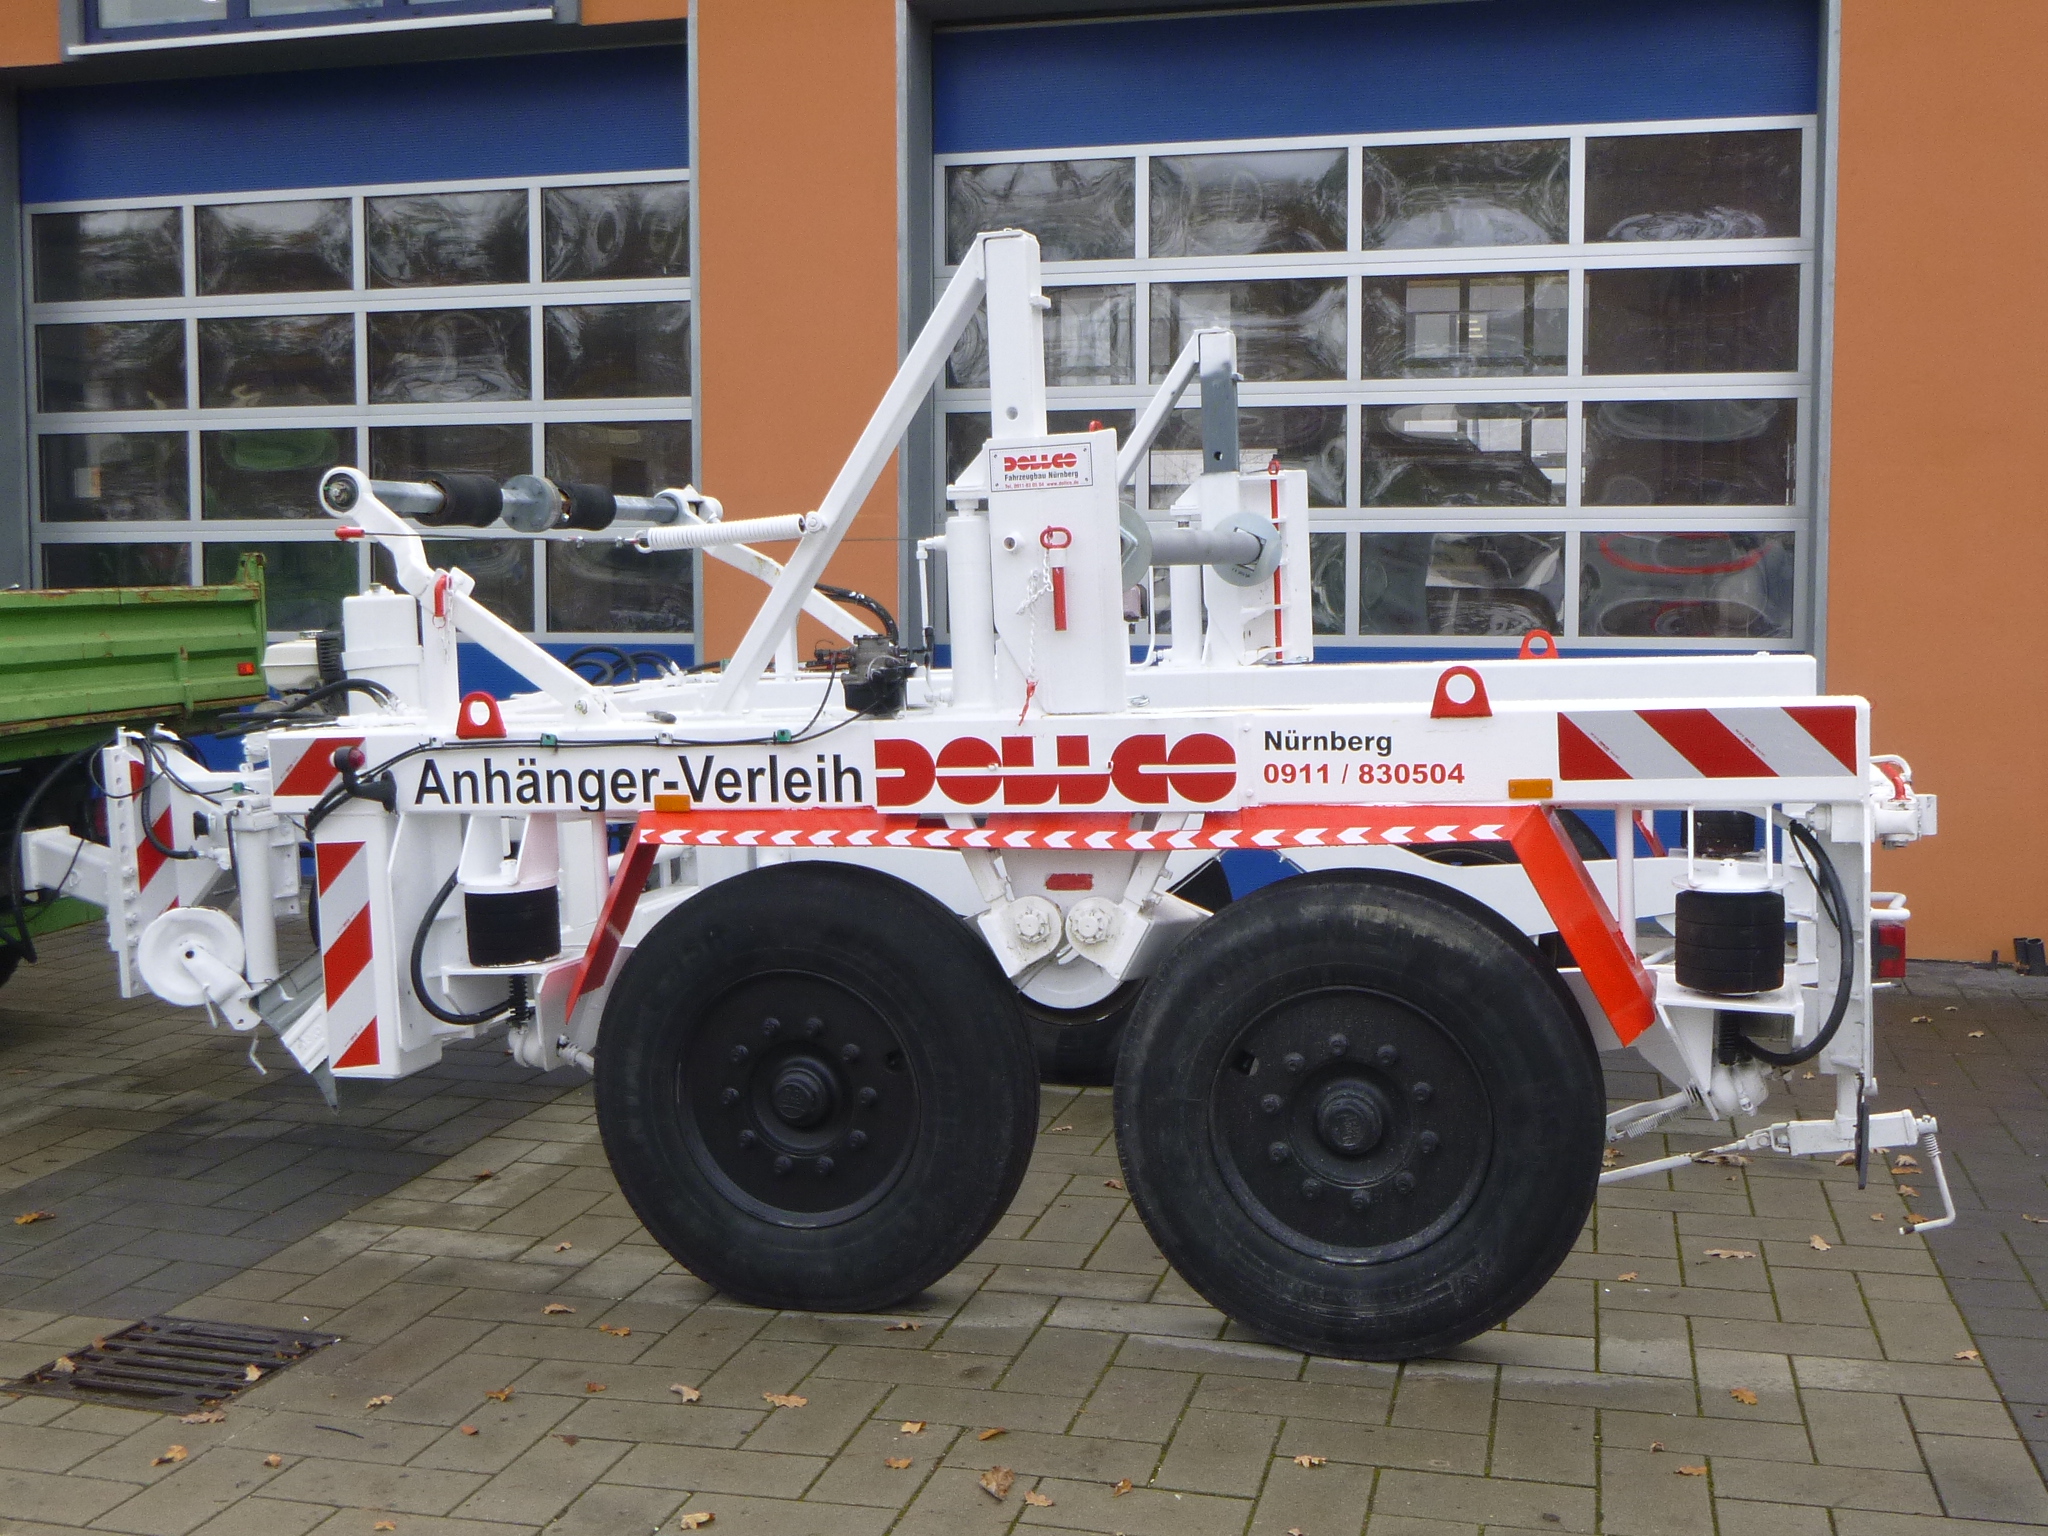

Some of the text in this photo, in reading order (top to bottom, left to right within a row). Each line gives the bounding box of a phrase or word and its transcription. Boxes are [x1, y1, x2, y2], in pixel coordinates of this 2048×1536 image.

[1004, 453, 1077, 472] DOLLCO
[1004, 470, 1079, 482] Fahrzeugbau Nürnberg
[1264, 729, 1392, 757] Nürnberg
[874, 733, 1237, 807] DOLLCO
[1263, 763, 1466, 784] 0911 / 830504
[414, 753, 863, 813] Anhänger-Verleih
